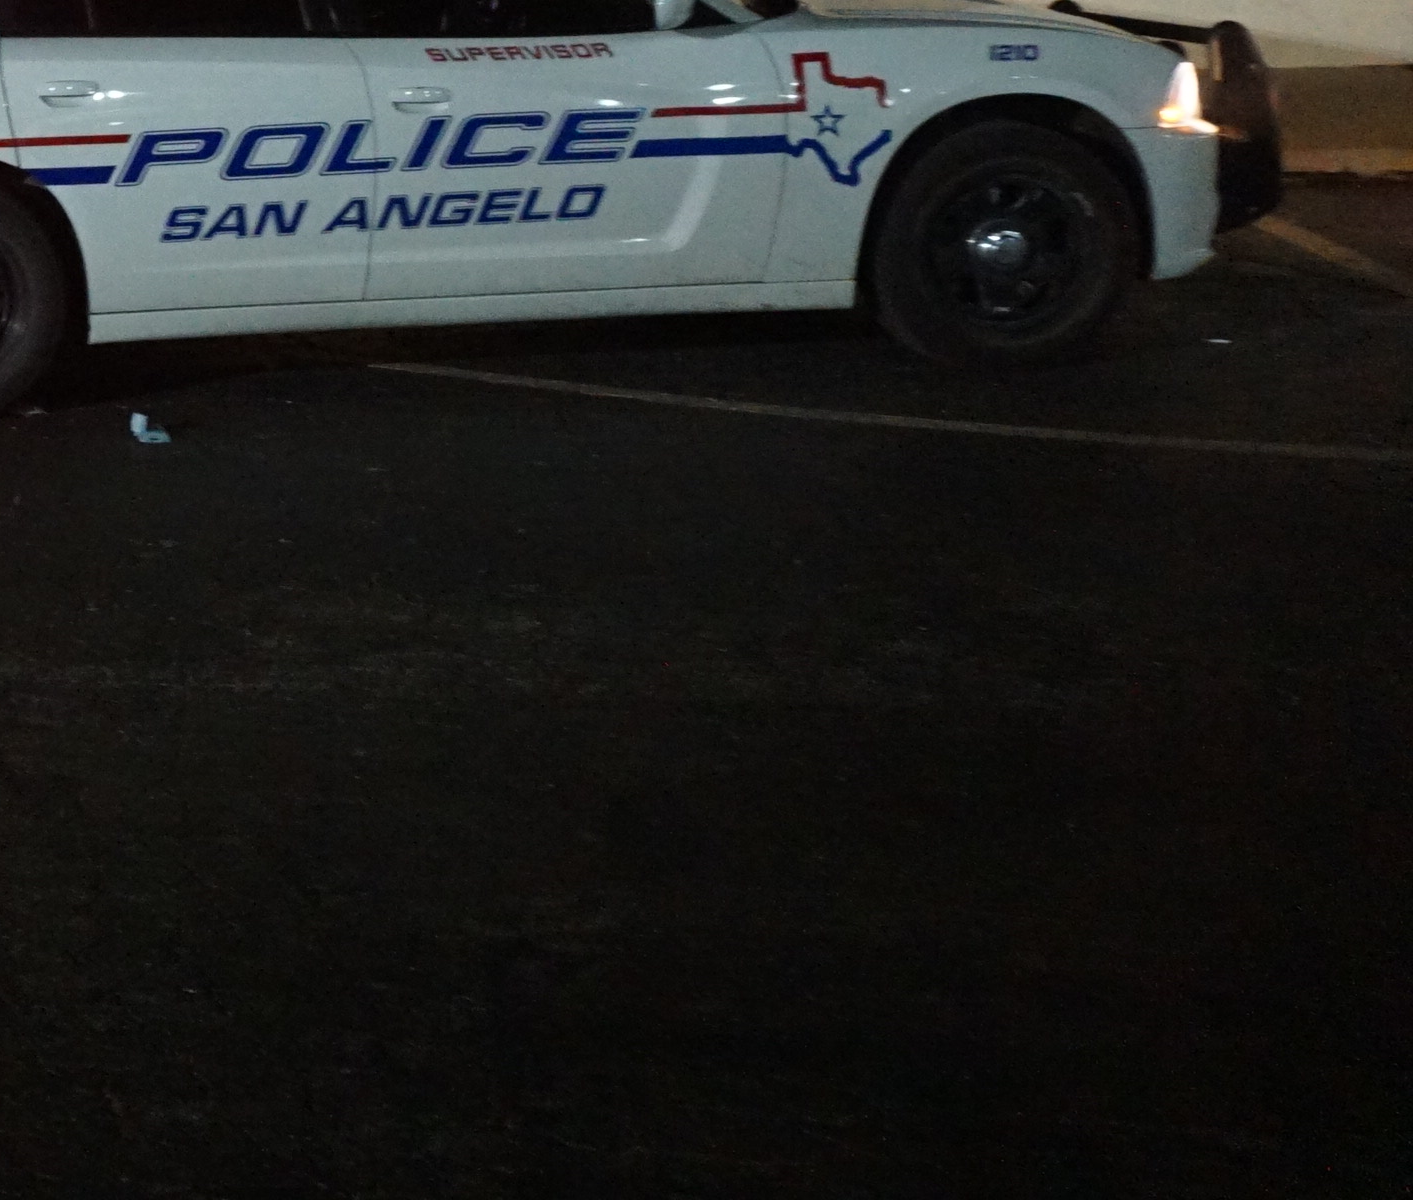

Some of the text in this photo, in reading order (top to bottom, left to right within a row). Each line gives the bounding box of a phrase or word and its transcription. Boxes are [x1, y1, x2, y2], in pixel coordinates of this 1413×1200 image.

[425, 43, 613, 61] SUPERVISOR
[989, 44, 1039, 61] 1210
[115, 107, 647, 186] POLICE
[160, 184, 607, 243] SAN ANGELO
